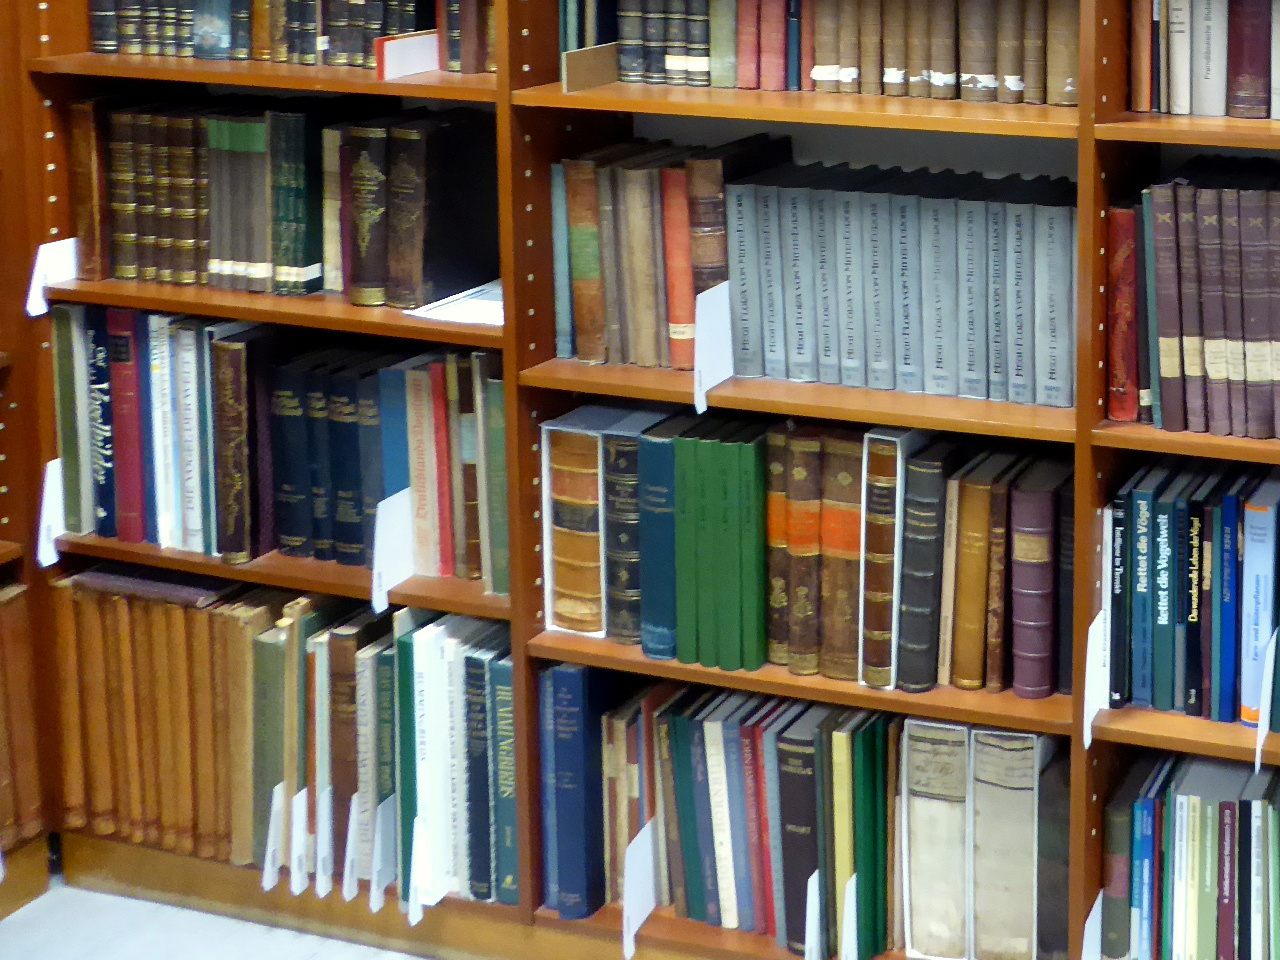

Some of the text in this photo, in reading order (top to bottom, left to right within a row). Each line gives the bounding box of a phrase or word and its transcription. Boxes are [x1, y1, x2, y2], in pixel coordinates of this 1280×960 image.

[1136, 500, 1150, 593] Rettet die Vögel
[1156, 514, 1172, 625] Rettet die Vogelwelt
[1189, 547, 1200, 570] Leben
